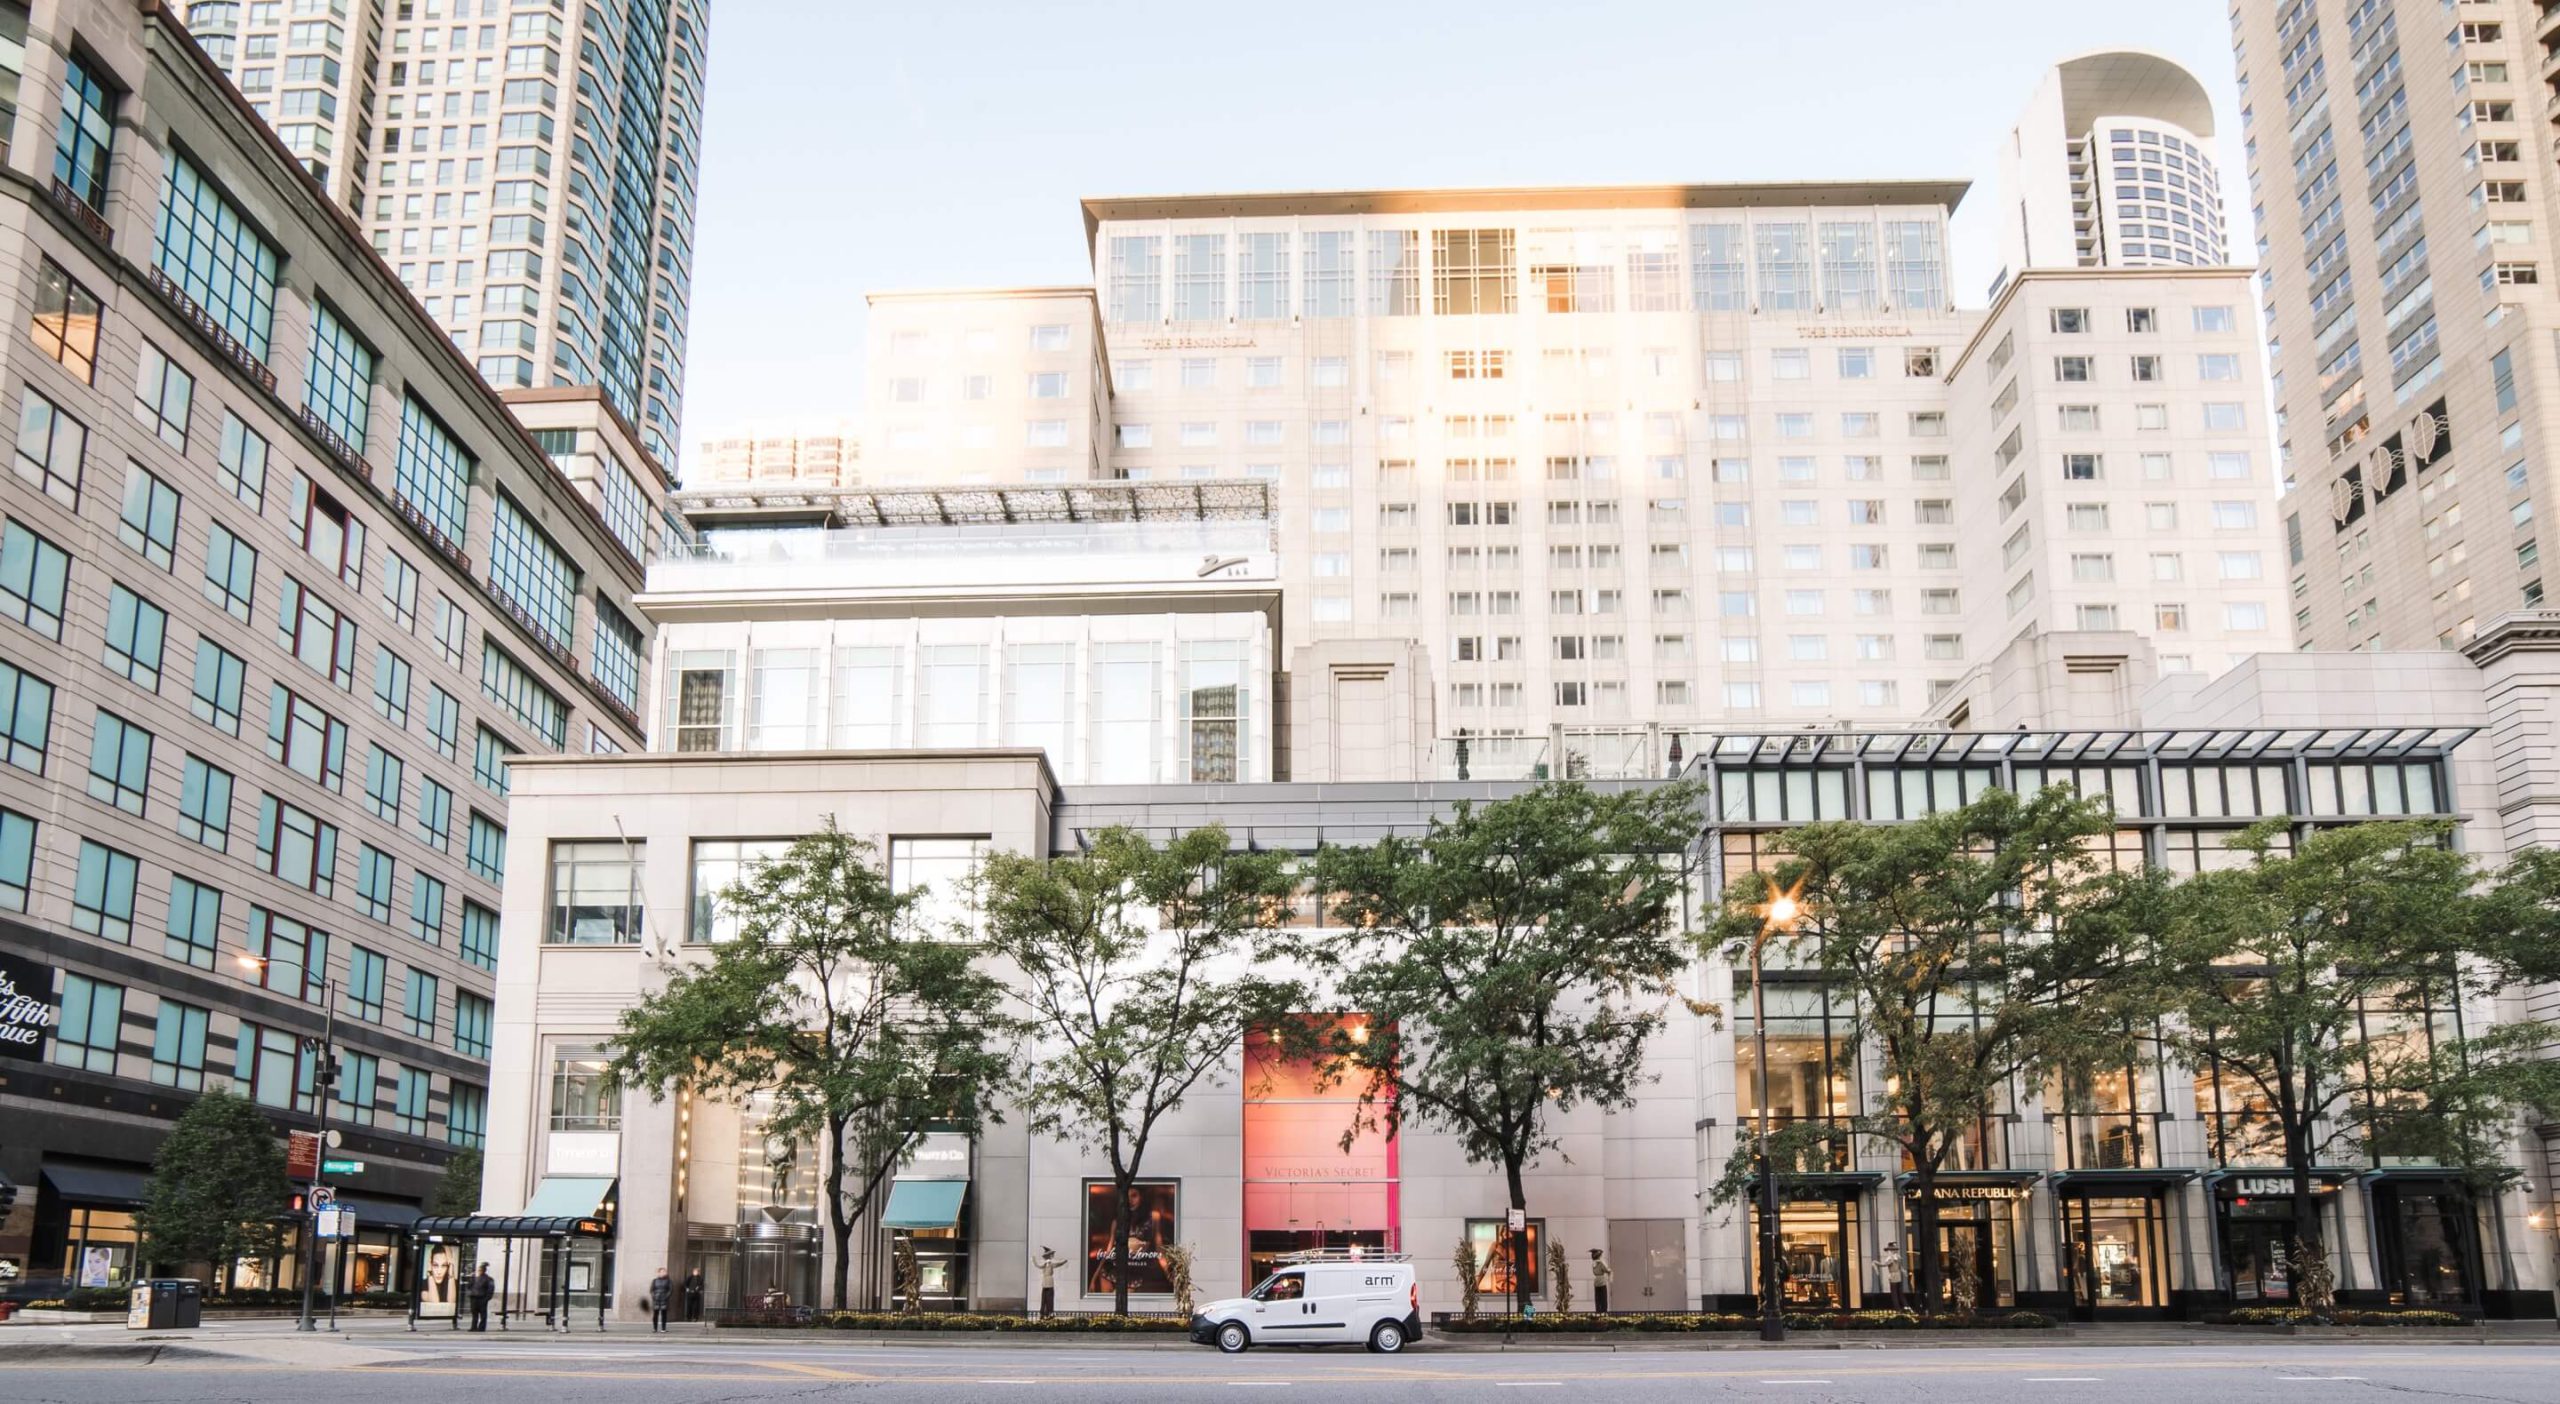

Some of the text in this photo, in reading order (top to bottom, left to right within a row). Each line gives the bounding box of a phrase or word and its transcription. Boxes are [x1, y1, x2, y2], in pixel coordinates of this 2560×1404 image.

[1831, 325, 1913, 338] PENINSULA
[1333, 1167, 1376, 1178] SECRET
[2236, 1178, 2296, 1195] LUSH
[1908, 1187, 2020, 1199] AANA REPUBLIC
[1365, 1274, 1395, 1286] arm
